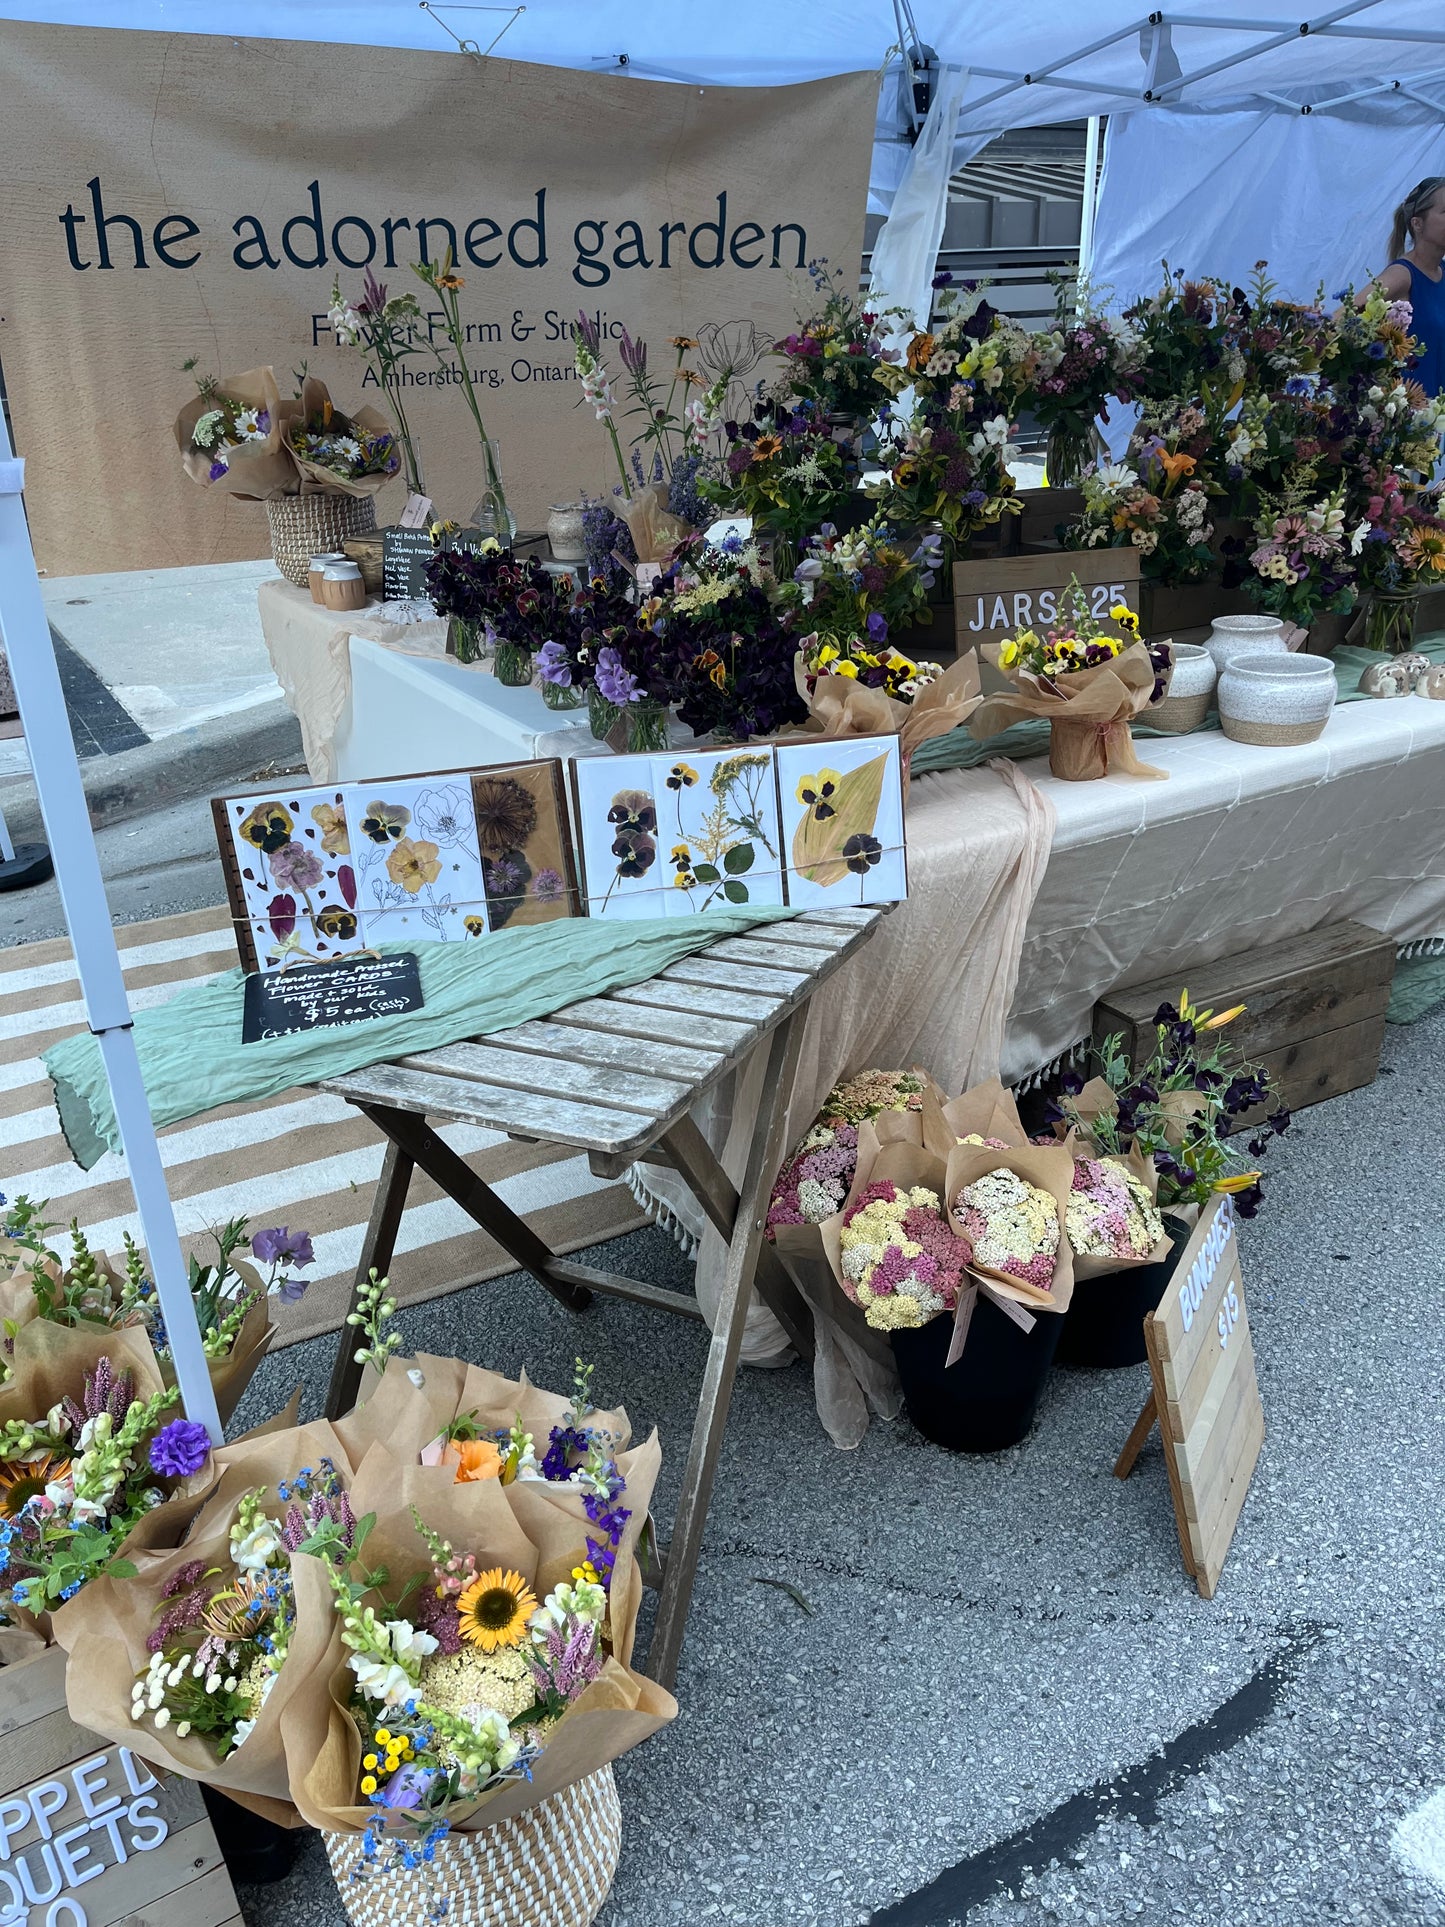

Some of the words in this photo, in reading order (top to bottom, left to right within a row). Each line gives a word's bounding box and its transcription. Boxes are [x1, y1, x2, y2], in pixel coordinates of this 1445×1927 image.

[59, 177, 201, 271] the
[232, 180, 549, 270] adorned
[572, 190, 808, 287] garden
[511, 310, 536, 341] &
[361, 361, 505, 389] Amherstburg,
[511, 358, 583, 382] Ontari
[385, 532, 403, 540] Small
[394, 540, 402, 548] by
[469, 542, 484, 556] Vas
[969, 591, 1058, 632] JARS
[263, 969, 350, 988] Handmade
[354, 959, 410, 973] Pressed
[268, 980, 324, 996] Flower
[331, 970, 393, 985] CARDS
[284, 992, 324, 1004] made
[340, 984, 380, 995] sold
[300, 1000, 318, 1010] by
[323, 995, 350, 1003] our
[356, 989, 387, 999] kids
[344, 1007, 367, 1015] ea
[1217, 1280, 1240, 1350] $15
